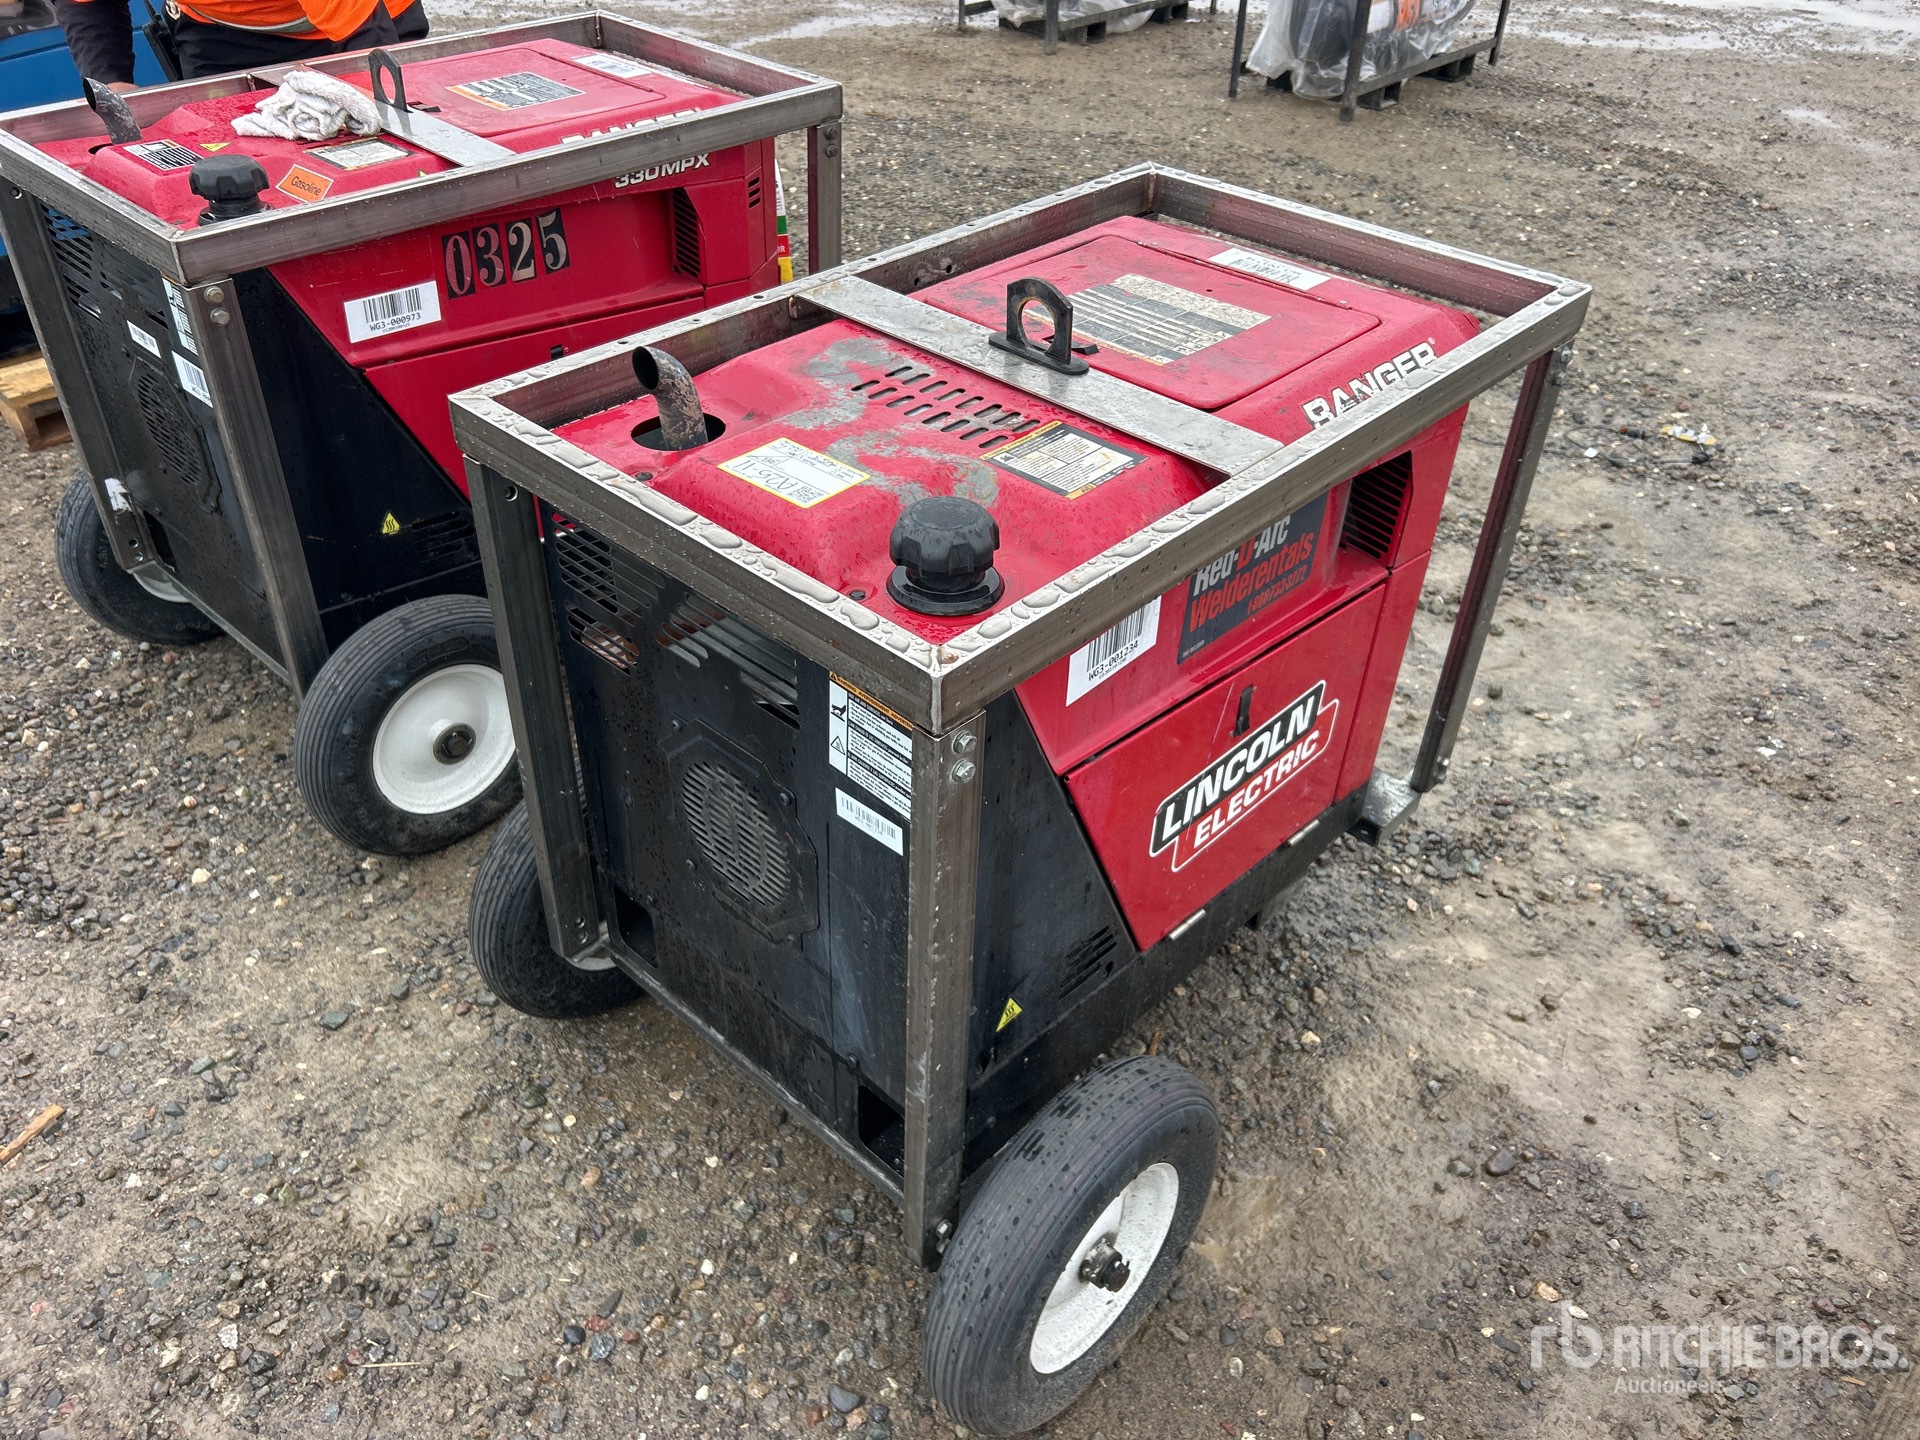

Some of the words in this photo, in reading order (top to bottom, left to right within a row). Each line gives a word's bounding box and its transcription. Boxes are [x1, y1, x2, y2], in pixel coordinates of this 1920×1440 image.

[291, 175, 322, 196] Gasoline
[614, 152, 710, 188] 330MPX
[445, 210, 568, 298] 0325
[369, 312, 421, 331] WG3-000973
[1301, 341, 1438, 429] RANGER
[1189, 531, 1315, 633] Welderentals
[1088, 639, 1139, 681] WG3-001234
[1161, 694, 1316, 842] LINCOLN
[1193, 729, 1320, 849] ELECTRIC
